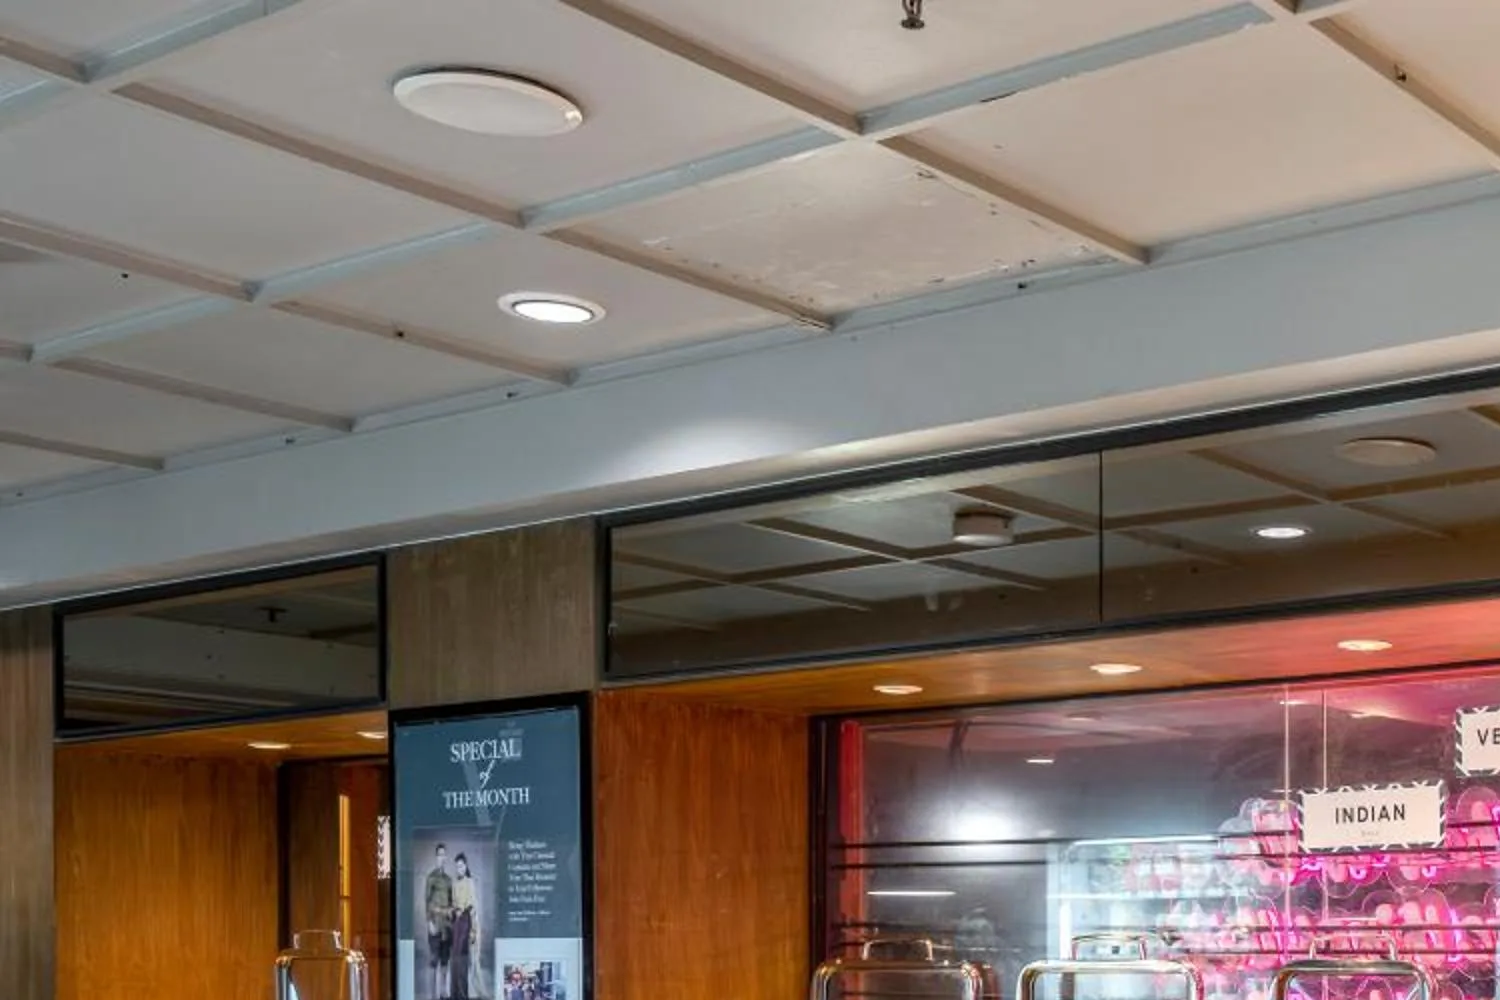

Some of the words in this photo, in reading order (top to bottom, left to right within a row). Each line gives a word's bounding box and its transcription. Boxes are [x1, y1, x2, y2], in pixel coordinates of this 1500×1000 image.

[450, 738, 521, 763] SPECIAL
[479, 760, 495, 790] of
[442, 791, 473, 808] THE
[475, 787, 529, 806] MONTH
[1334, 803, 1406, 825] INDIAN
